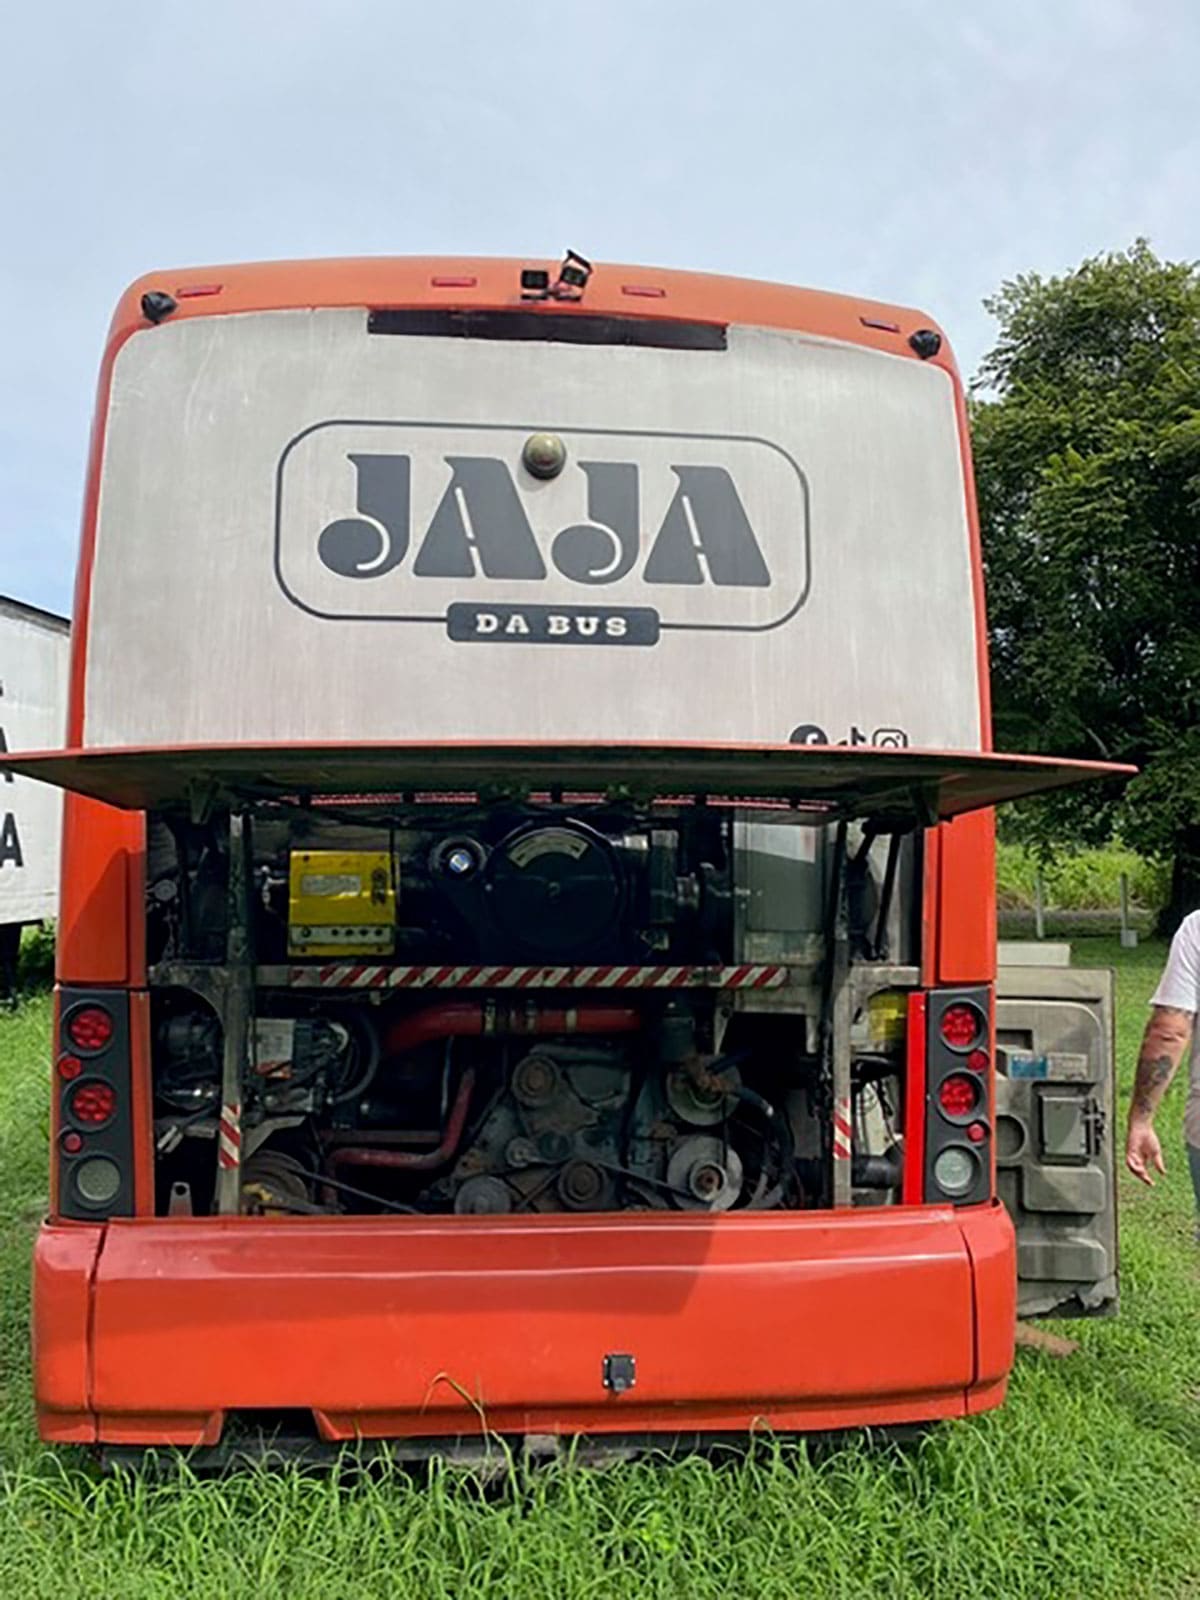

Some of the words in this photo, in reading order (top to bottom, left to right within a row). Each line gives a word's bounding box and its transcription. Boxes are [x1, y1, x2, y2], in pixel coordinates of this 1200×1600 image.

[317, 453, 772, 586] JAJA
[476, 613, 530, 634] DA
[547, 615, 628, 637] BUS
